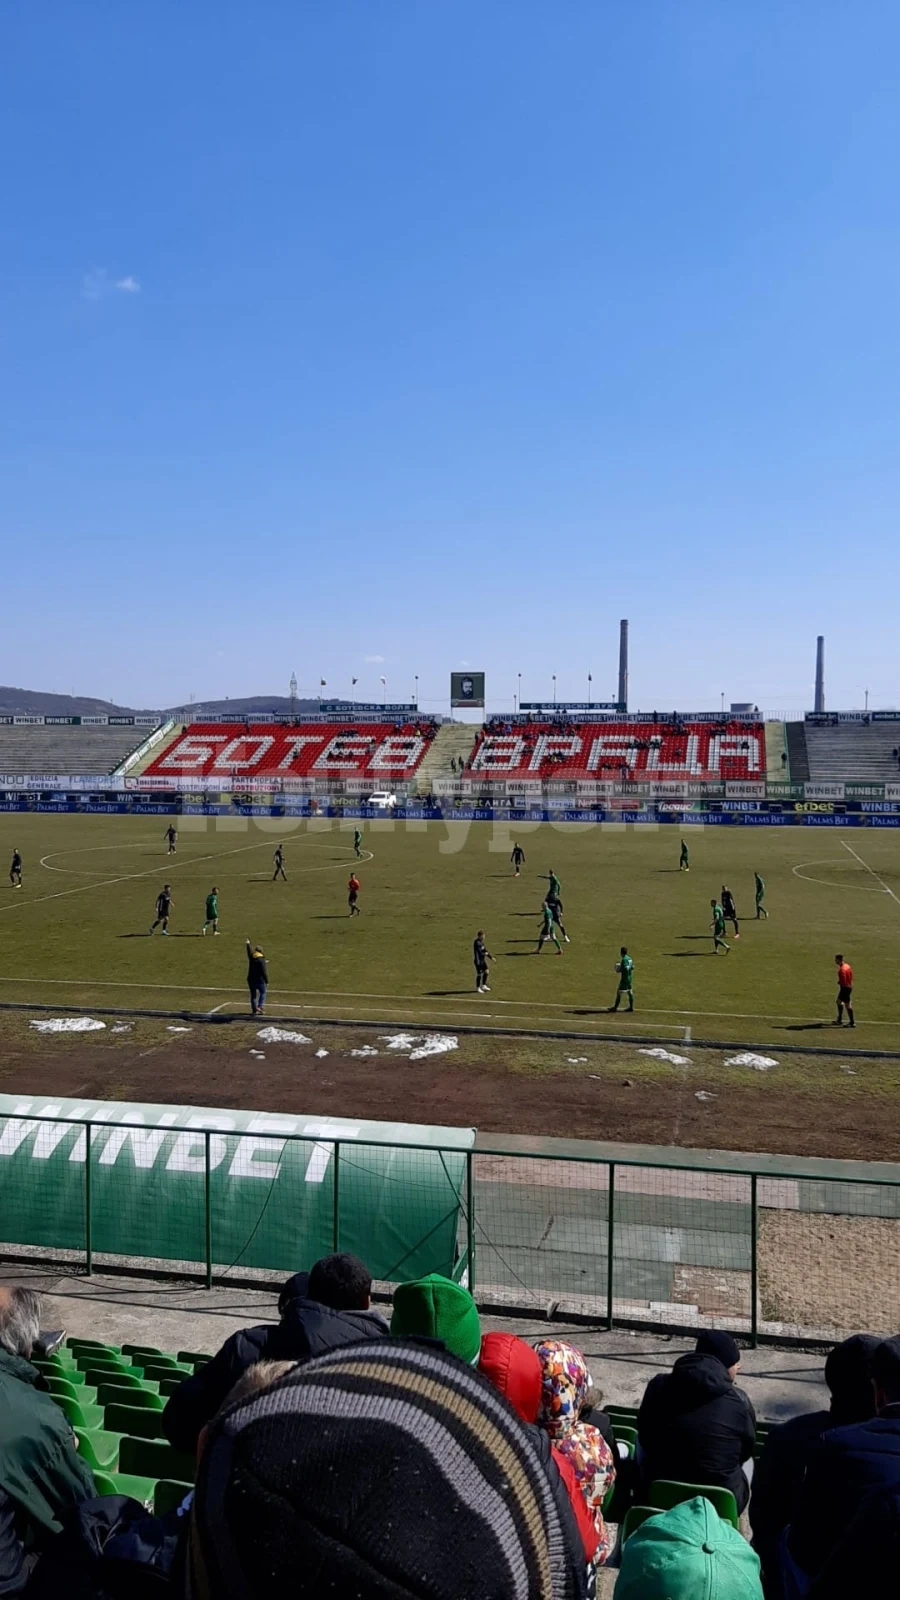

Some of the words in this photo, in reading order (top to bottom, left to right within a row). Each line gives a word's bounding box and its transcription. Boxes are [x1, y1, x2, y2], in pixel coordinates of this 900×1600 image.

[730, 712, 761, 720] WINBET
[157, 735, 426, 770] БОТЕВ
[471, 735, 761, 775] ВРАЦА
[315, 781, 346, 789] WINBET
[347, 782, 378, 790] WINBET
[380, 782, 411, 790] WINBET
[438, 783, 470, 791] WINBET
[472, 783, 505, 791] WINBET
[507, 783, 540, 791] WINBET
[543, 784, 576, 792] WINBET
[578, 784, 612, 792] WINBET
[614, 784, 649, 793] WINBET
[652, 785, 686, 793] WINBET
[689, 785, 724, 793] WINBET
[728, 785, 764, 794] WINBET
[767, 786, 803, 794] WINBET
[806, 787, 842, 795] WINBET
[845, 787, 883, 796] WINBET
[722, 801, 762, 811] WINBET
[794, 802, 834, 811] efbet
[0, 1102, 361, 1184] WINBET
